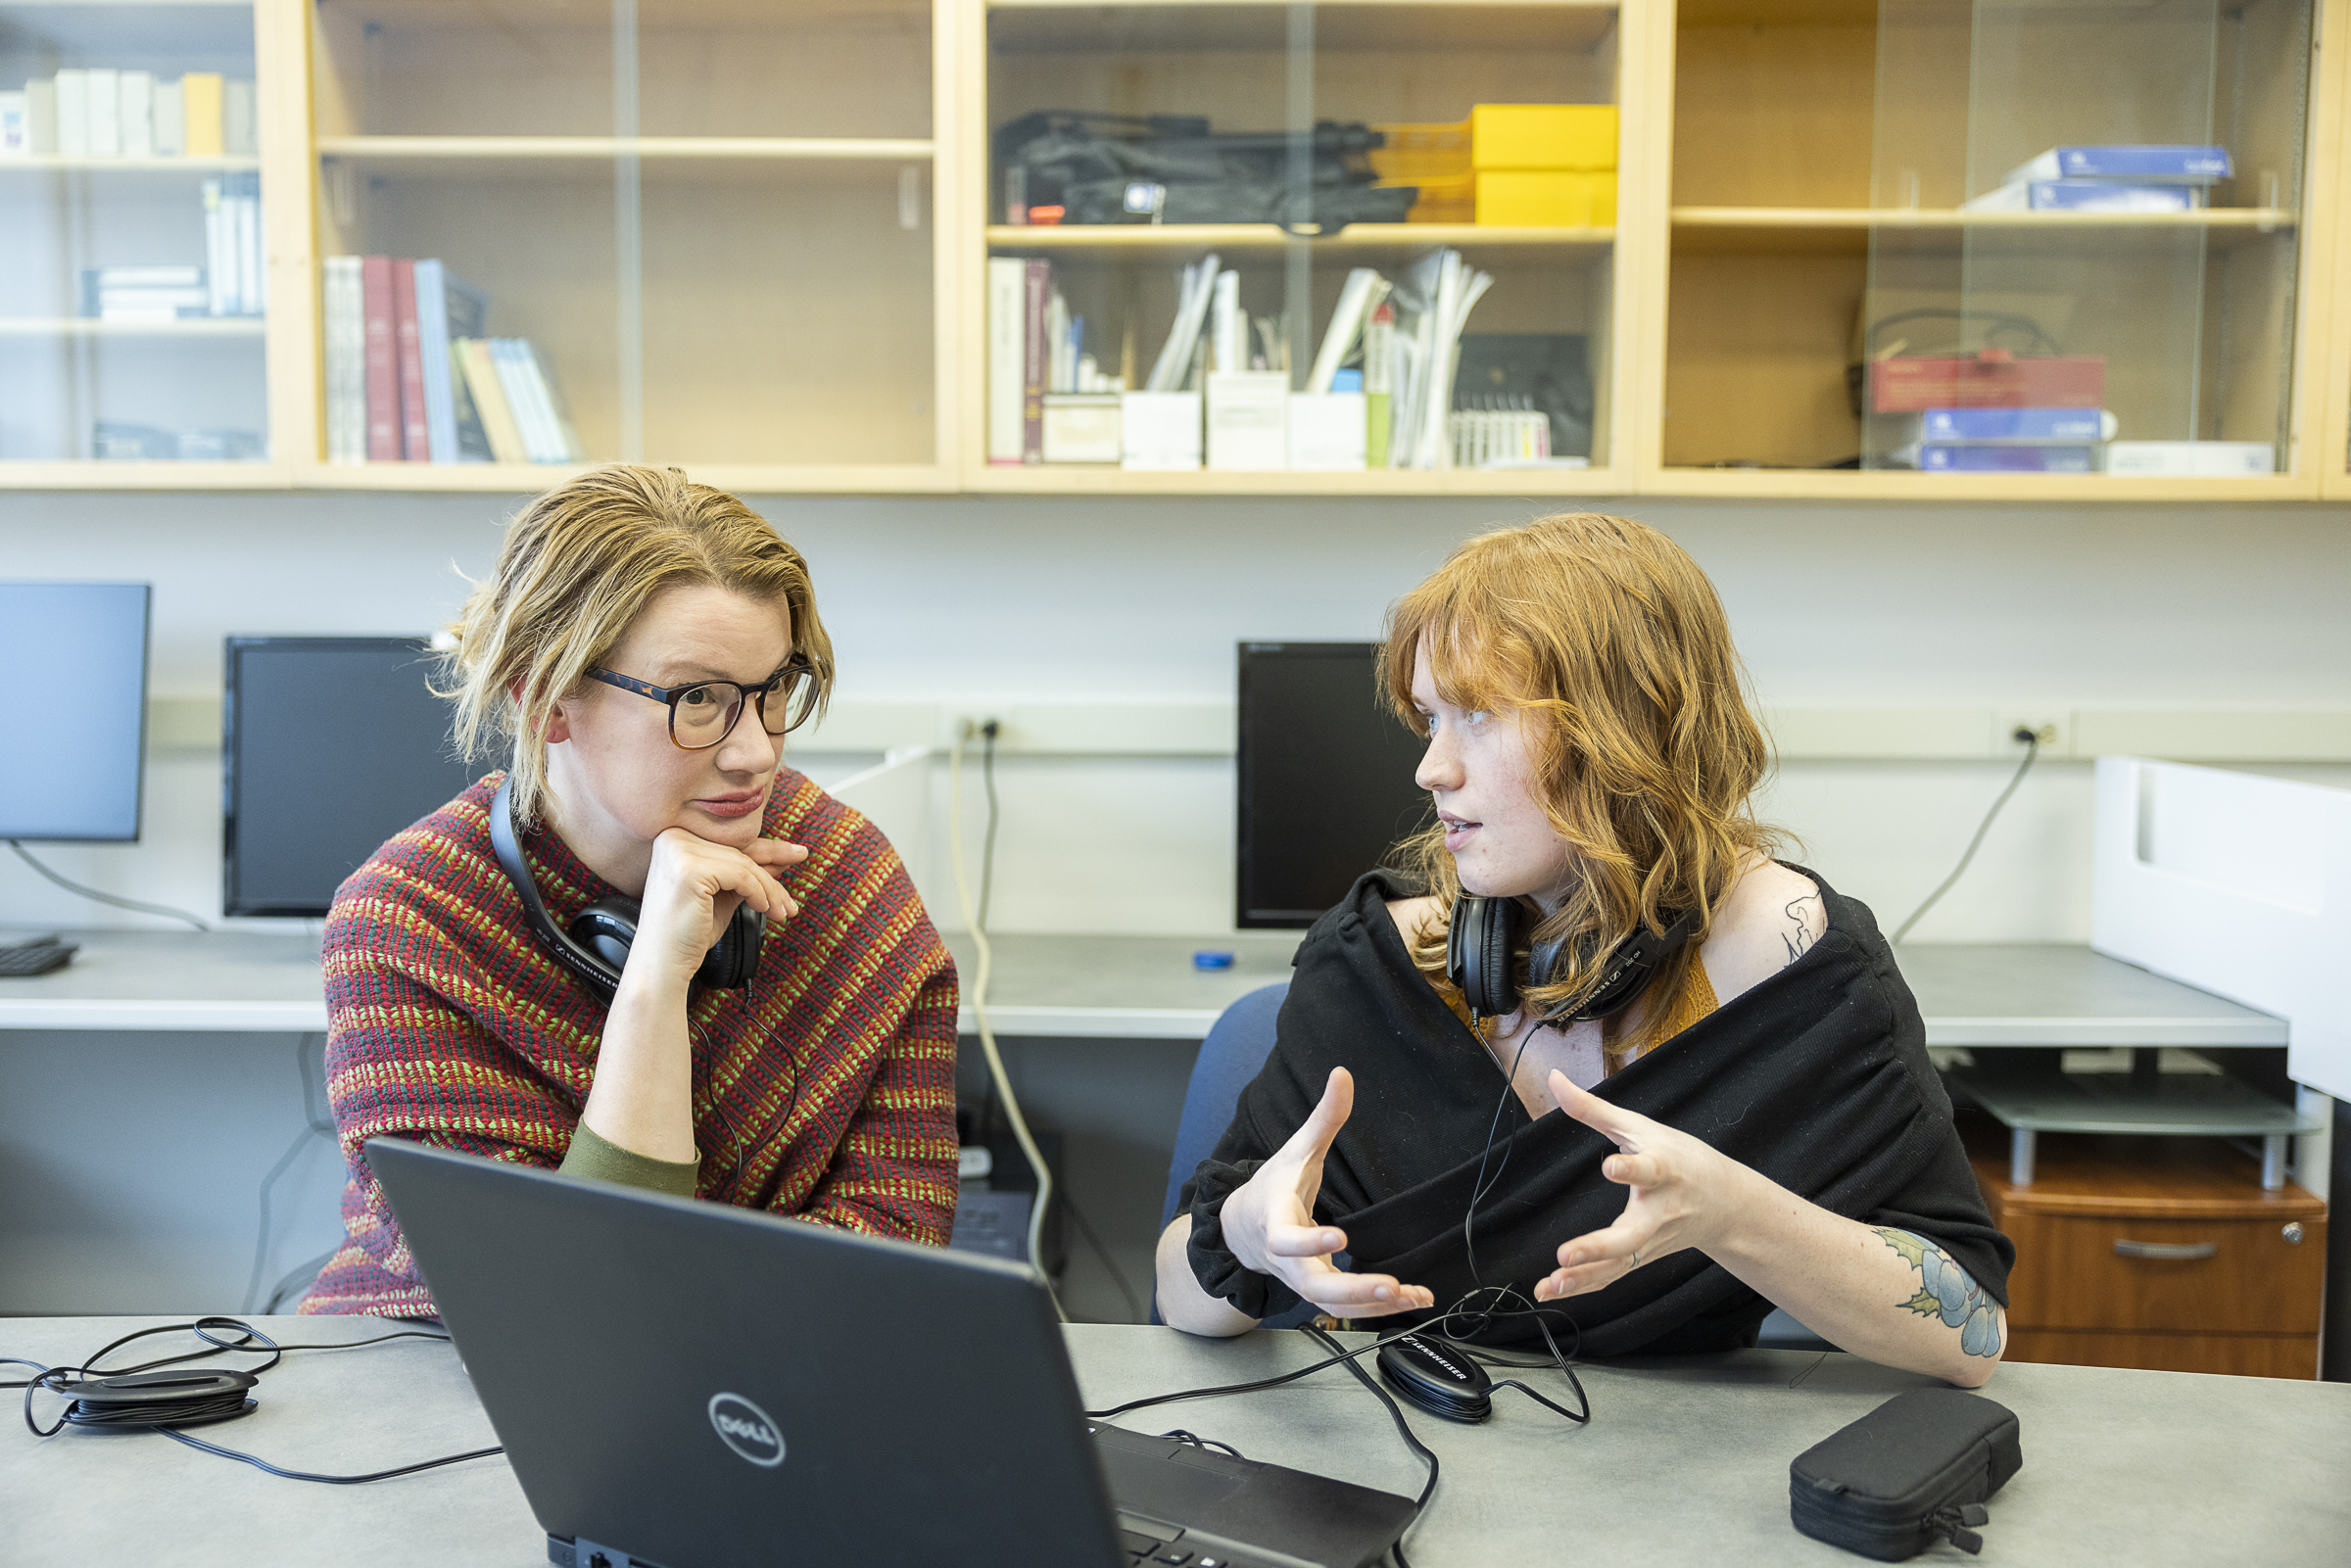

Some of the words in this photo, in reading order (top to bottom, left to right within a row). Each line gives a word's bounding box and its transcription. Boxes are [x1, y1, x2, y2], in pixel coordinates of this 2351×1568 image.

[565, 952, 619, 988] SENNHEISER
[1412, 1342, 1467, 1380] SENNHEISER
[718, 1413, 777, 1447] DELL
